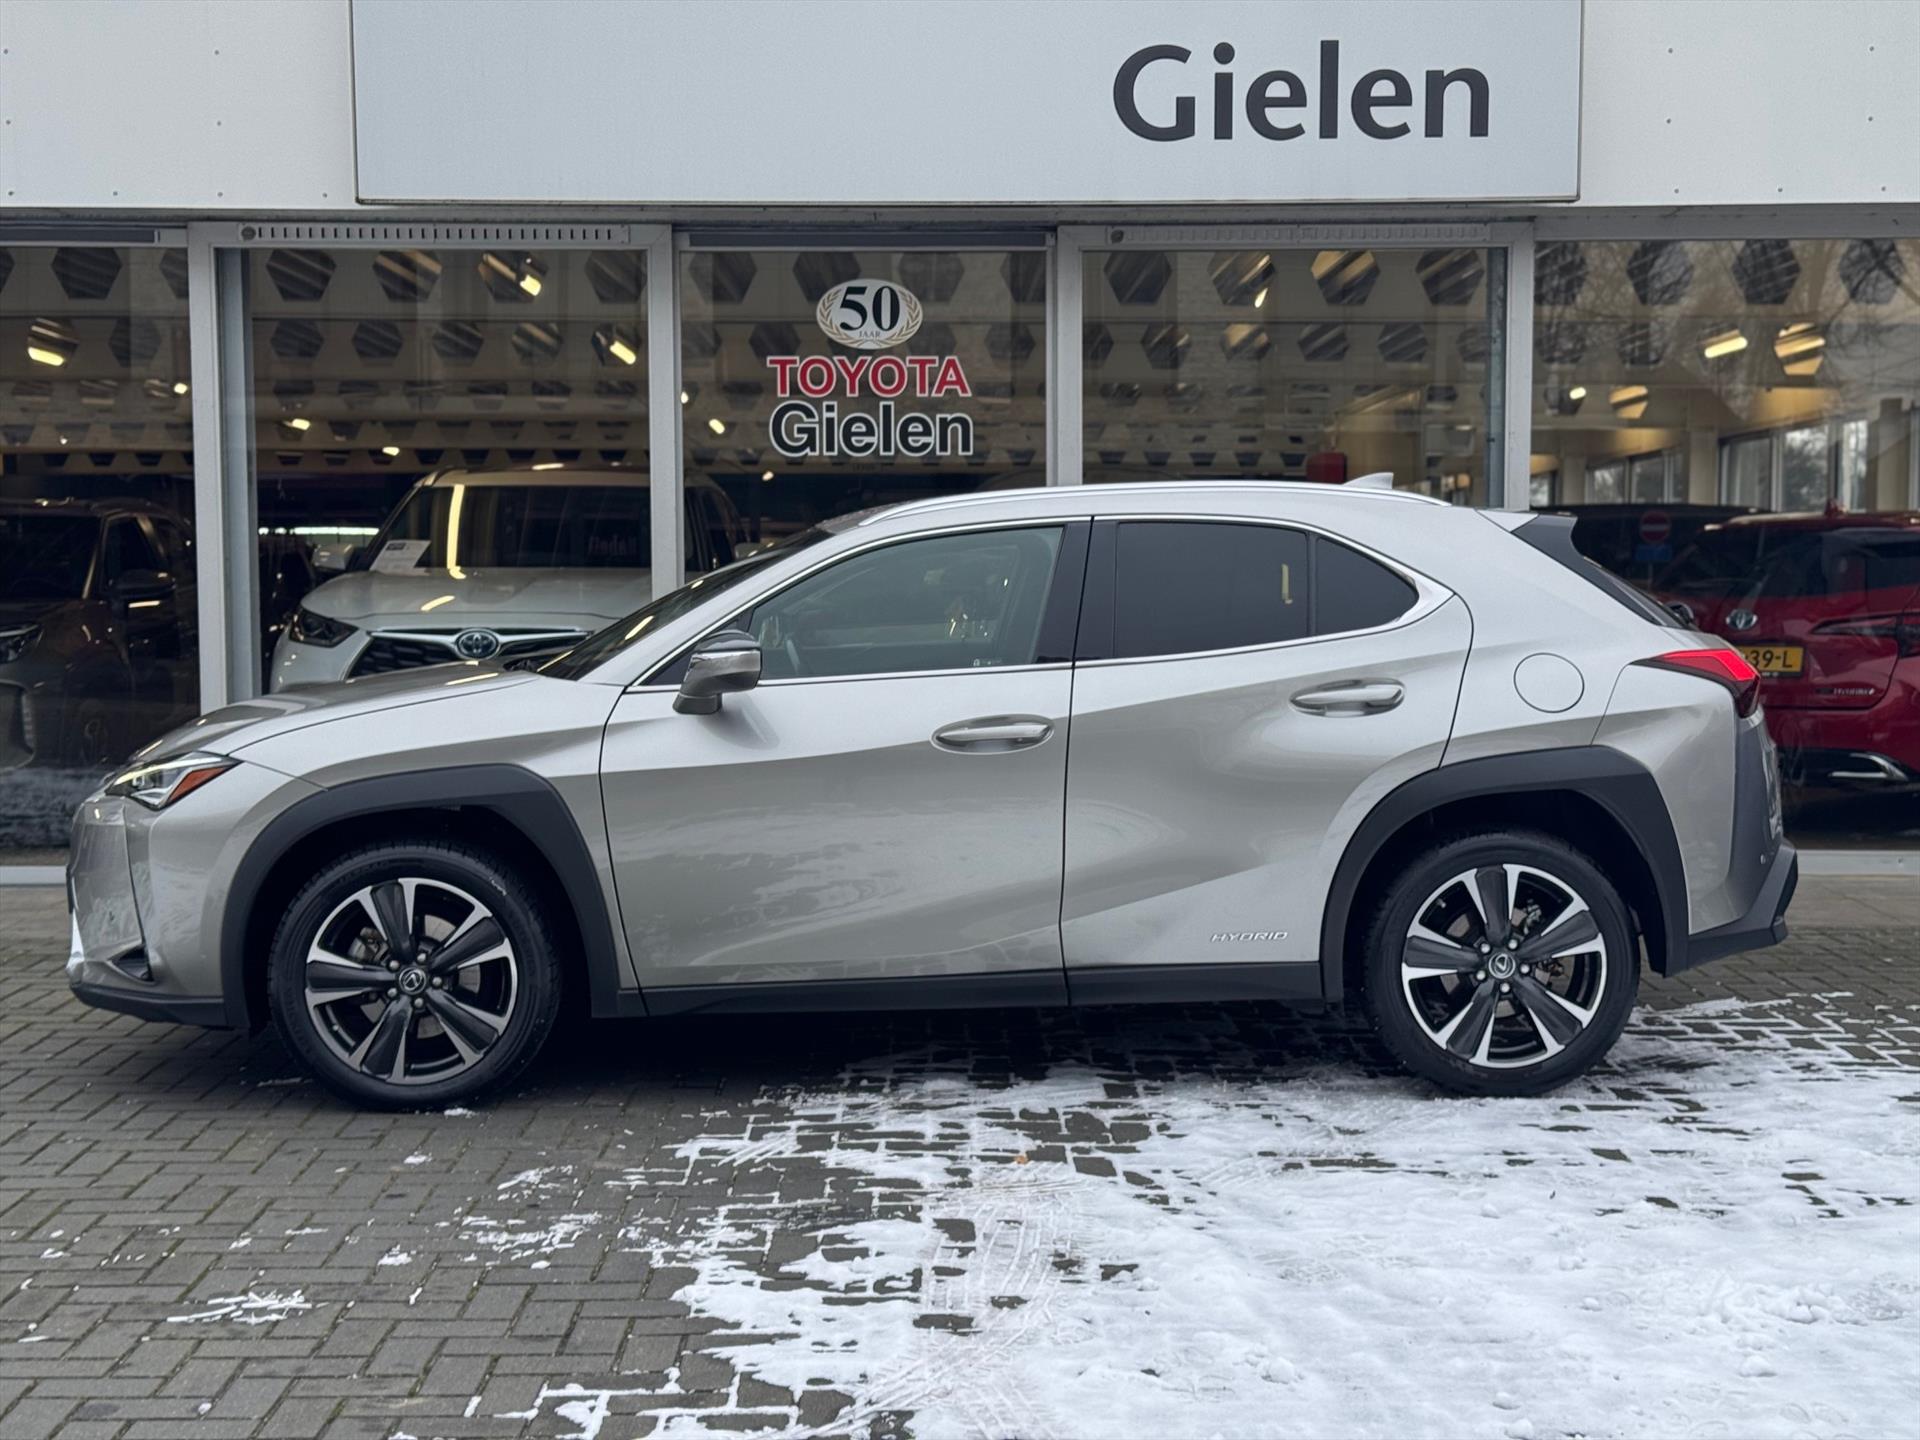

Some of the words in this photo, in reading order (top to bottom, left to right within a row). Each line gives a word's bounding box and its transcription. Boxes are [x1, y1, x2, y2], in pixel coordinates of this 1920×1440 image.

[1113, 40, 1490, 142] Gielen
[839, 285, 901, 332] 50
[858, 330, 881, 338] JAAR
[767, 355, 973, 397] TOYOTA
[769, 400, 974, 457] Gielen
[1210, 931, 1288, 942] HYBRID
